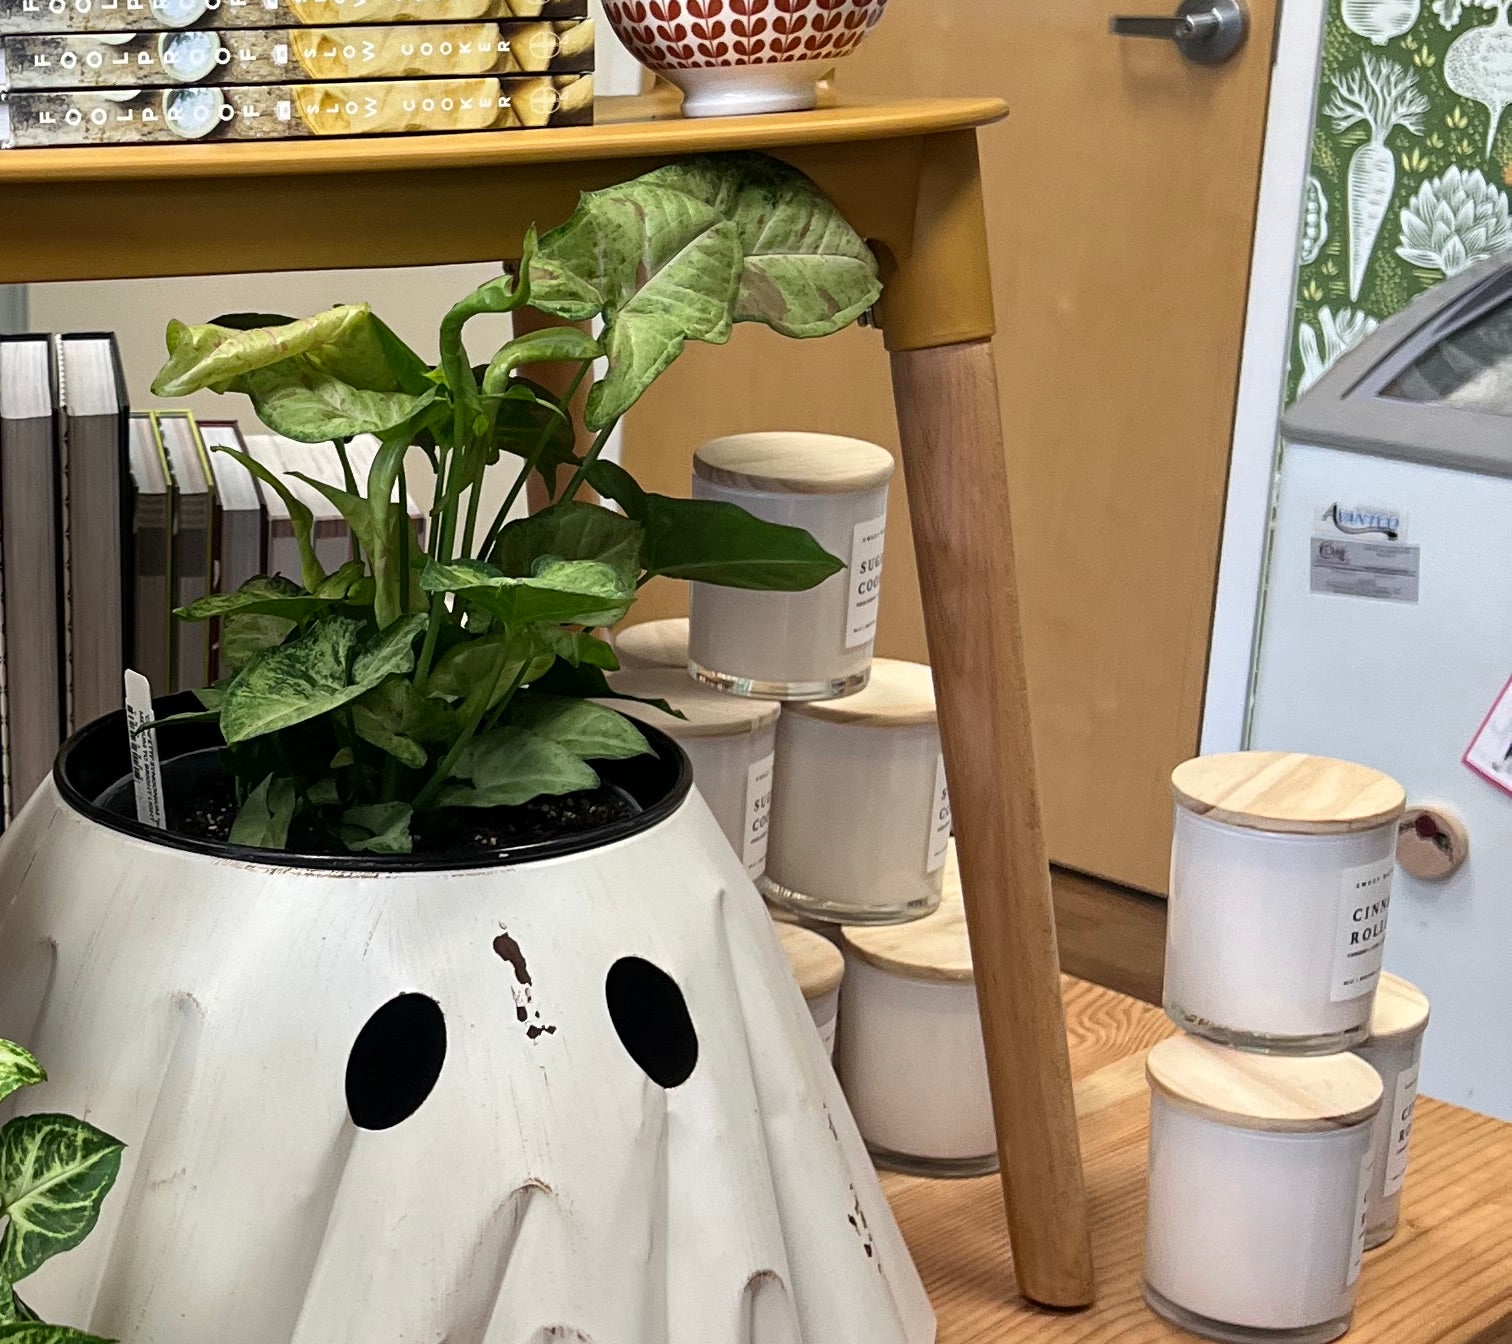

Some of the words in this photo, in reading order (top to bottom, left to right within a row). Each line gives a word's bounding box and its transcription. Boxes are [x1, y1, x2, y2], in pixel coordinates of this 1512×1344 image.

[34, 47, 257, 70] FOOLPROOF
[304, 40, 376, 62] SLOW
[401, 39, 512, 56] COOKER
[40, 104, 261, 126] FOOLPROOF
[307, 96, 378, 118] SLOW
[403, 95, 512, 112] COOKER
[859, 555, 881, 575] SUG
[1352, 897, 1390, 923] CINN
